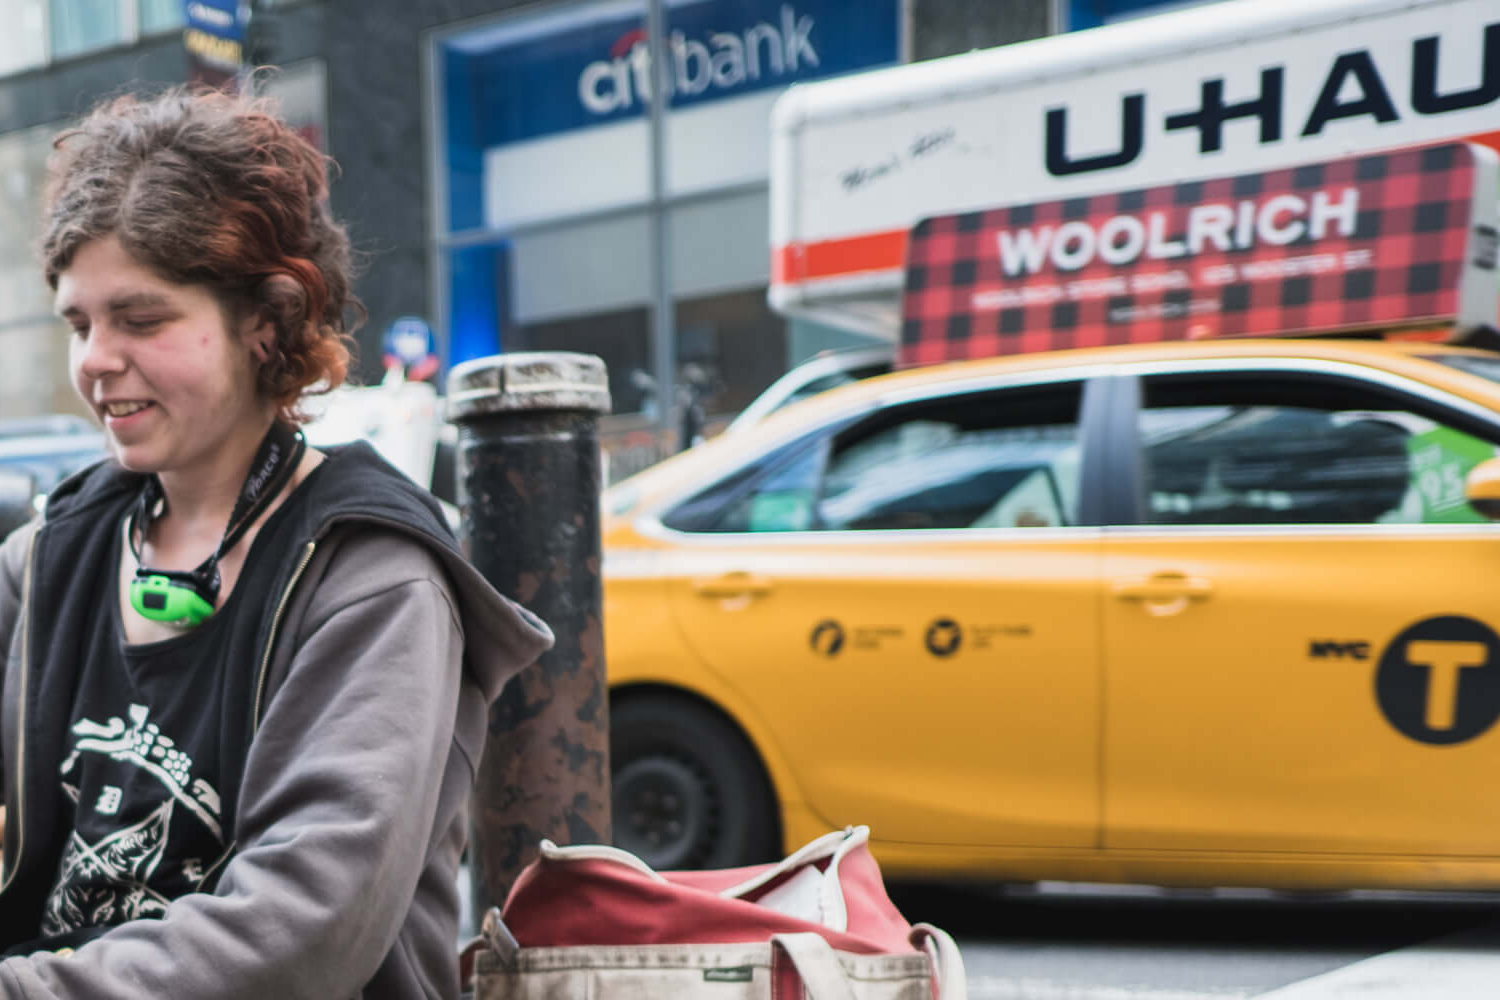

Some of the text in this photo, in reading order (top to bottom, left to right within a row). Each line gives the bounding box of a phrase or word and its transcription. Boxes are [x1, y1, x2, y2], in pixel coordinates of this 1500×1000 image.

[578, 3, 820, 115] citbank
[998, 187, 1360, 277] WOOLRICH
[1308, 638, 1491, 731] NYC T
